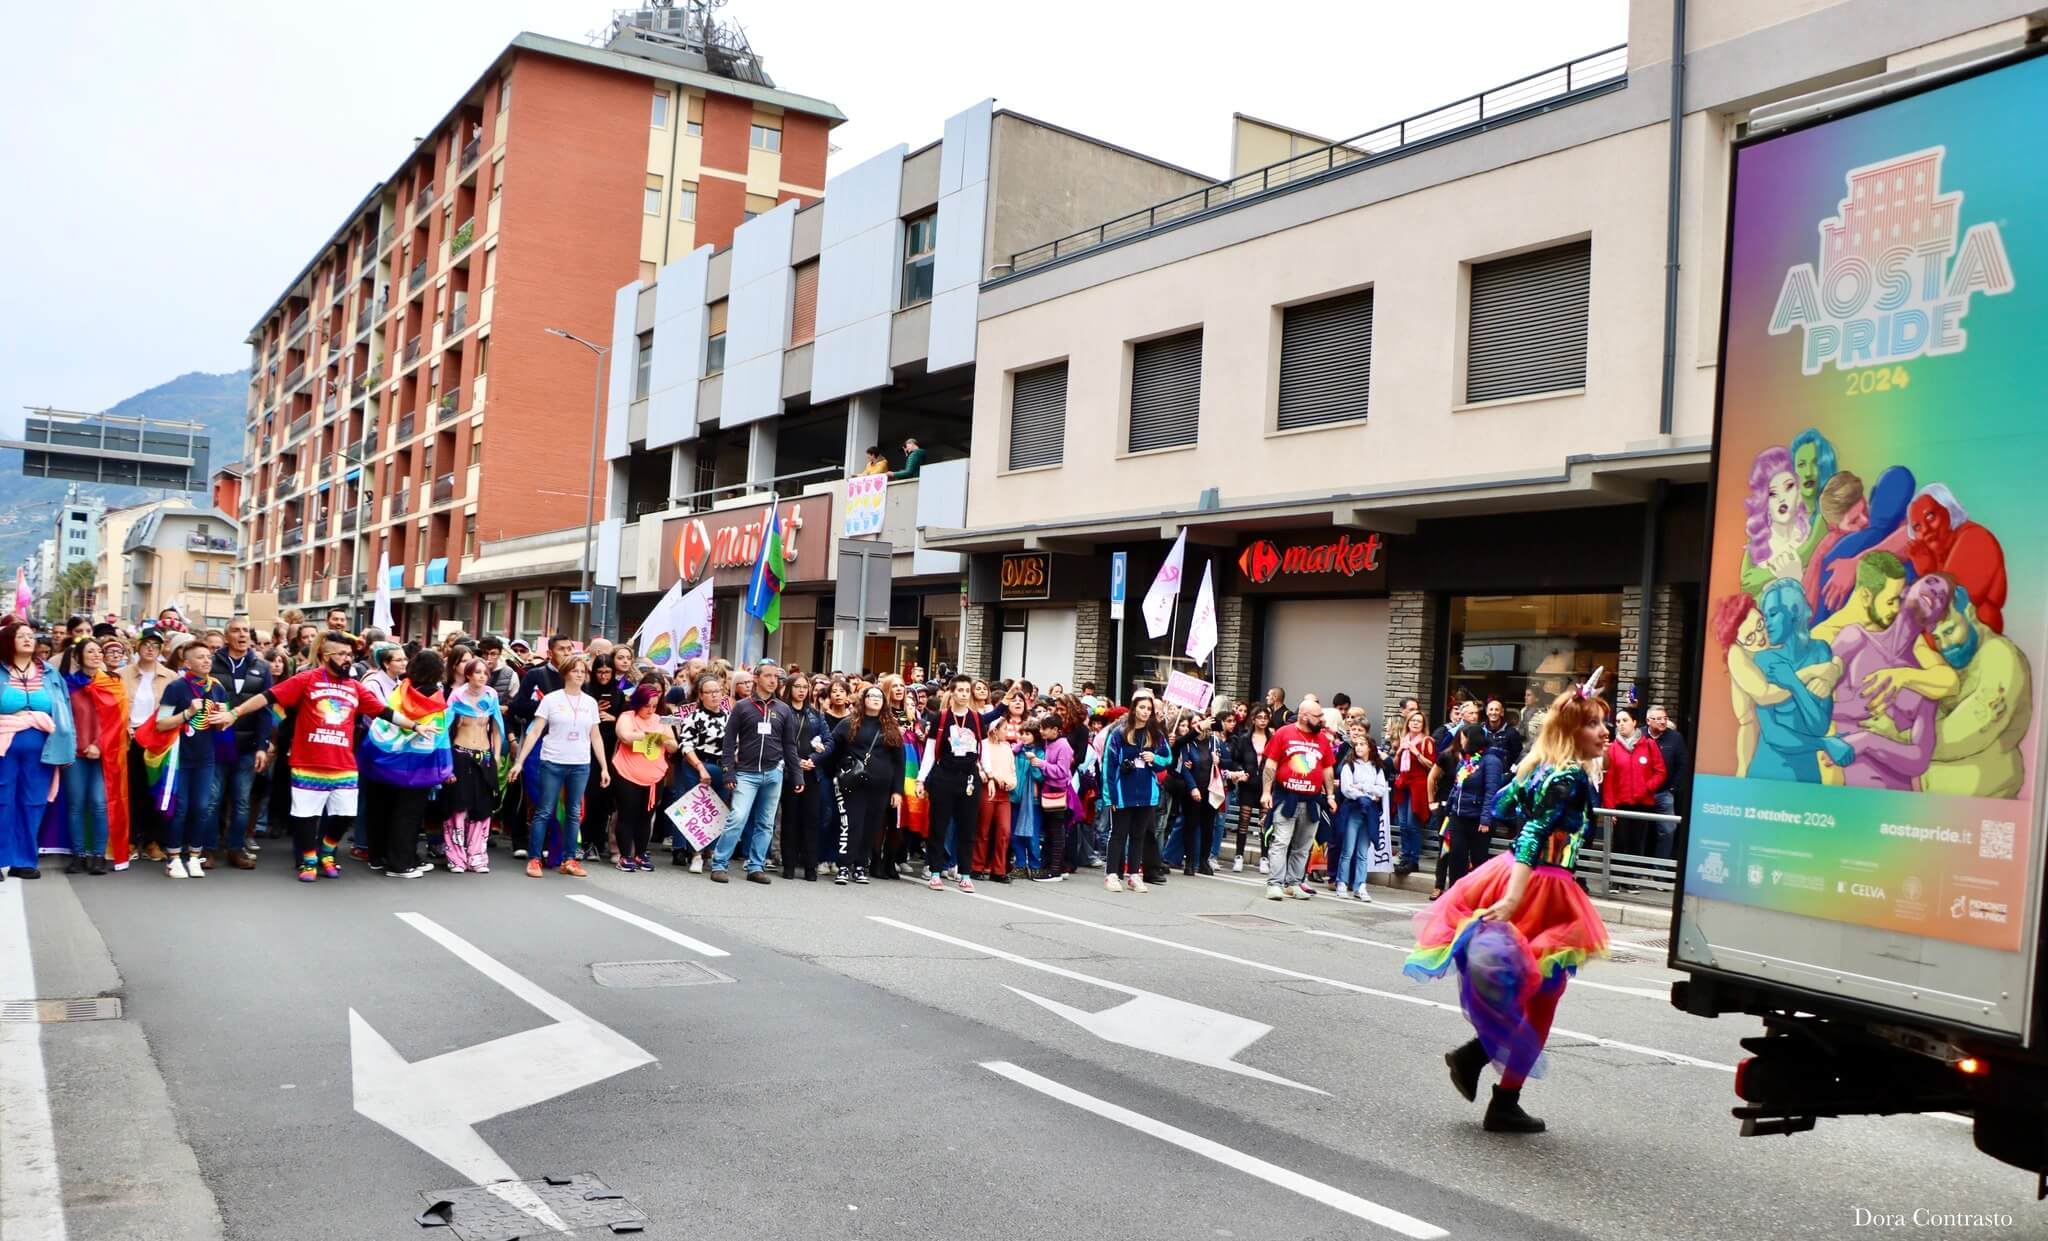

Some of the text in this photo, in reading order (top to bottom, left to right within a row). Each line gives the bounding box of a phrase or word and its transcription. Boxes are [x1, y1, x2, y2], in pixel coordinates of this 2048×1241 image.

[1770, 225, 2012, 333] AOSTA
[1803, 300, 1966, 373] PRIDE
[1846, 366, 1909, 396] 2024
[710, 503, 804, 569] mart
[1282, 531, 1382, 576] market
[1113, 558, 1123, 598] P
[838, 814, 849, 855] NIKE
[1702, 802, 1742, 817] sabato
[1756, 809, 1802, 825] ottobre
[1803, 812, 1836, 829] 2024
[1879, 822, 1974, 846] aostapride.it
[1850, 882, 1886, 900] CELVA
